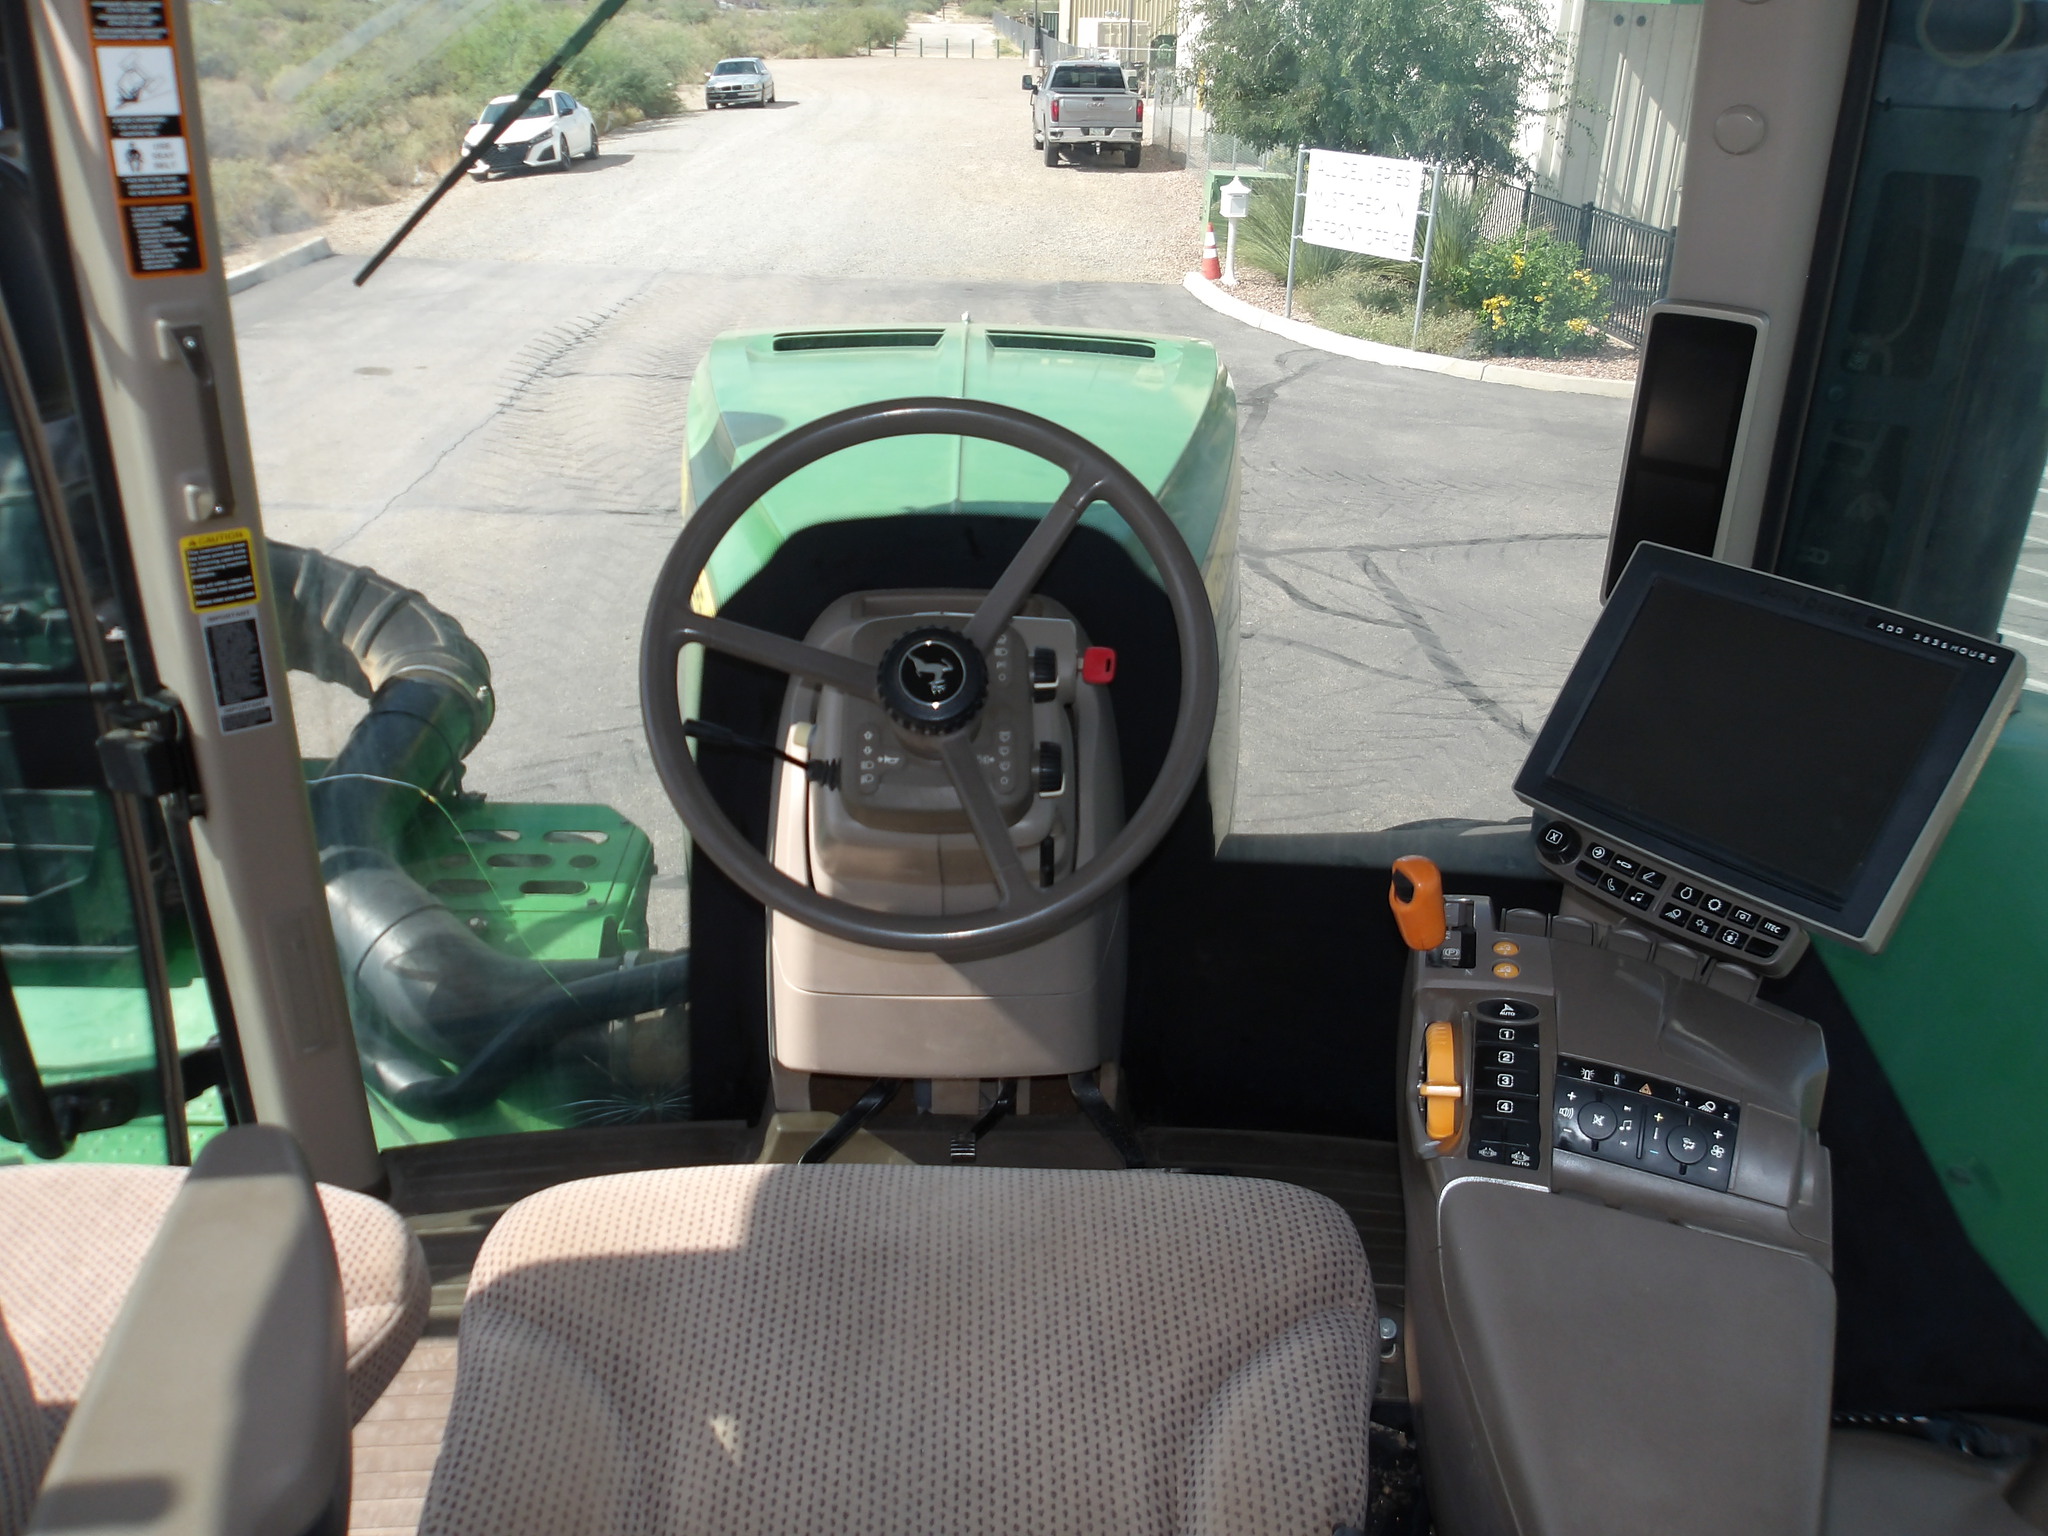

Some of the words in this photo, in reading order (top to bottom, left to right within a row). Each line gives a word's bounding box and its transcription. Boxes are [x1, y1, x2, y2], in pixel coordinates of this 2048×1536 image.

[1340, 161, 1412, 187] DELERES
[1365, 227, 1410, 253] OFFCE
[1876, 621, 1905, 635] ADD
